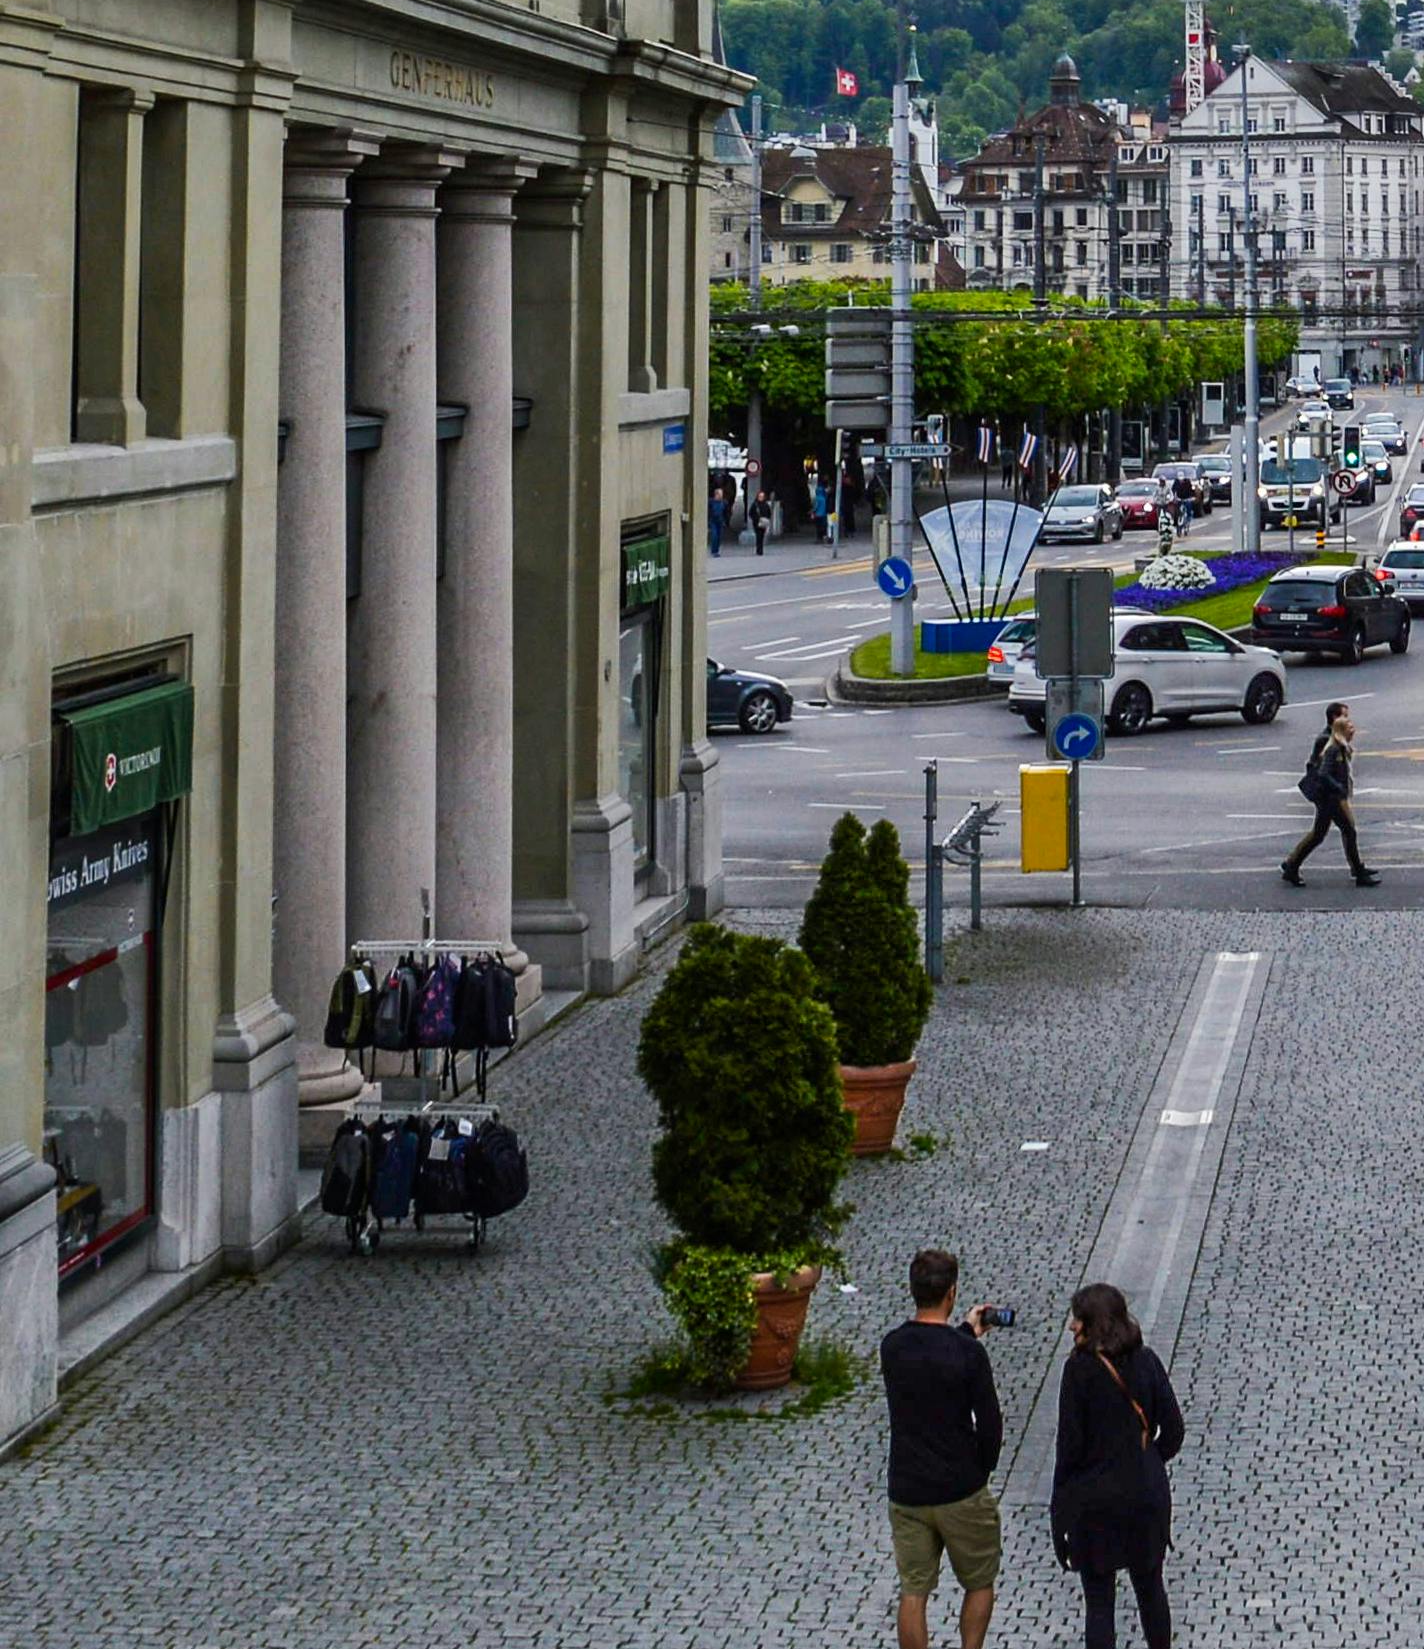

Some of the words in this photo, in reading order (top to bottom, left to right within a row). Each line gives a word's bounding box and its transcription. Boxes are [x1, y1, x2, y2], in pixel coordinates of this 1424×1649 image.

[390, 51, 496, 109] GENFERHAUS
[80, 855, 112, 888] Army
[113, 839, 149, 874] Knives
